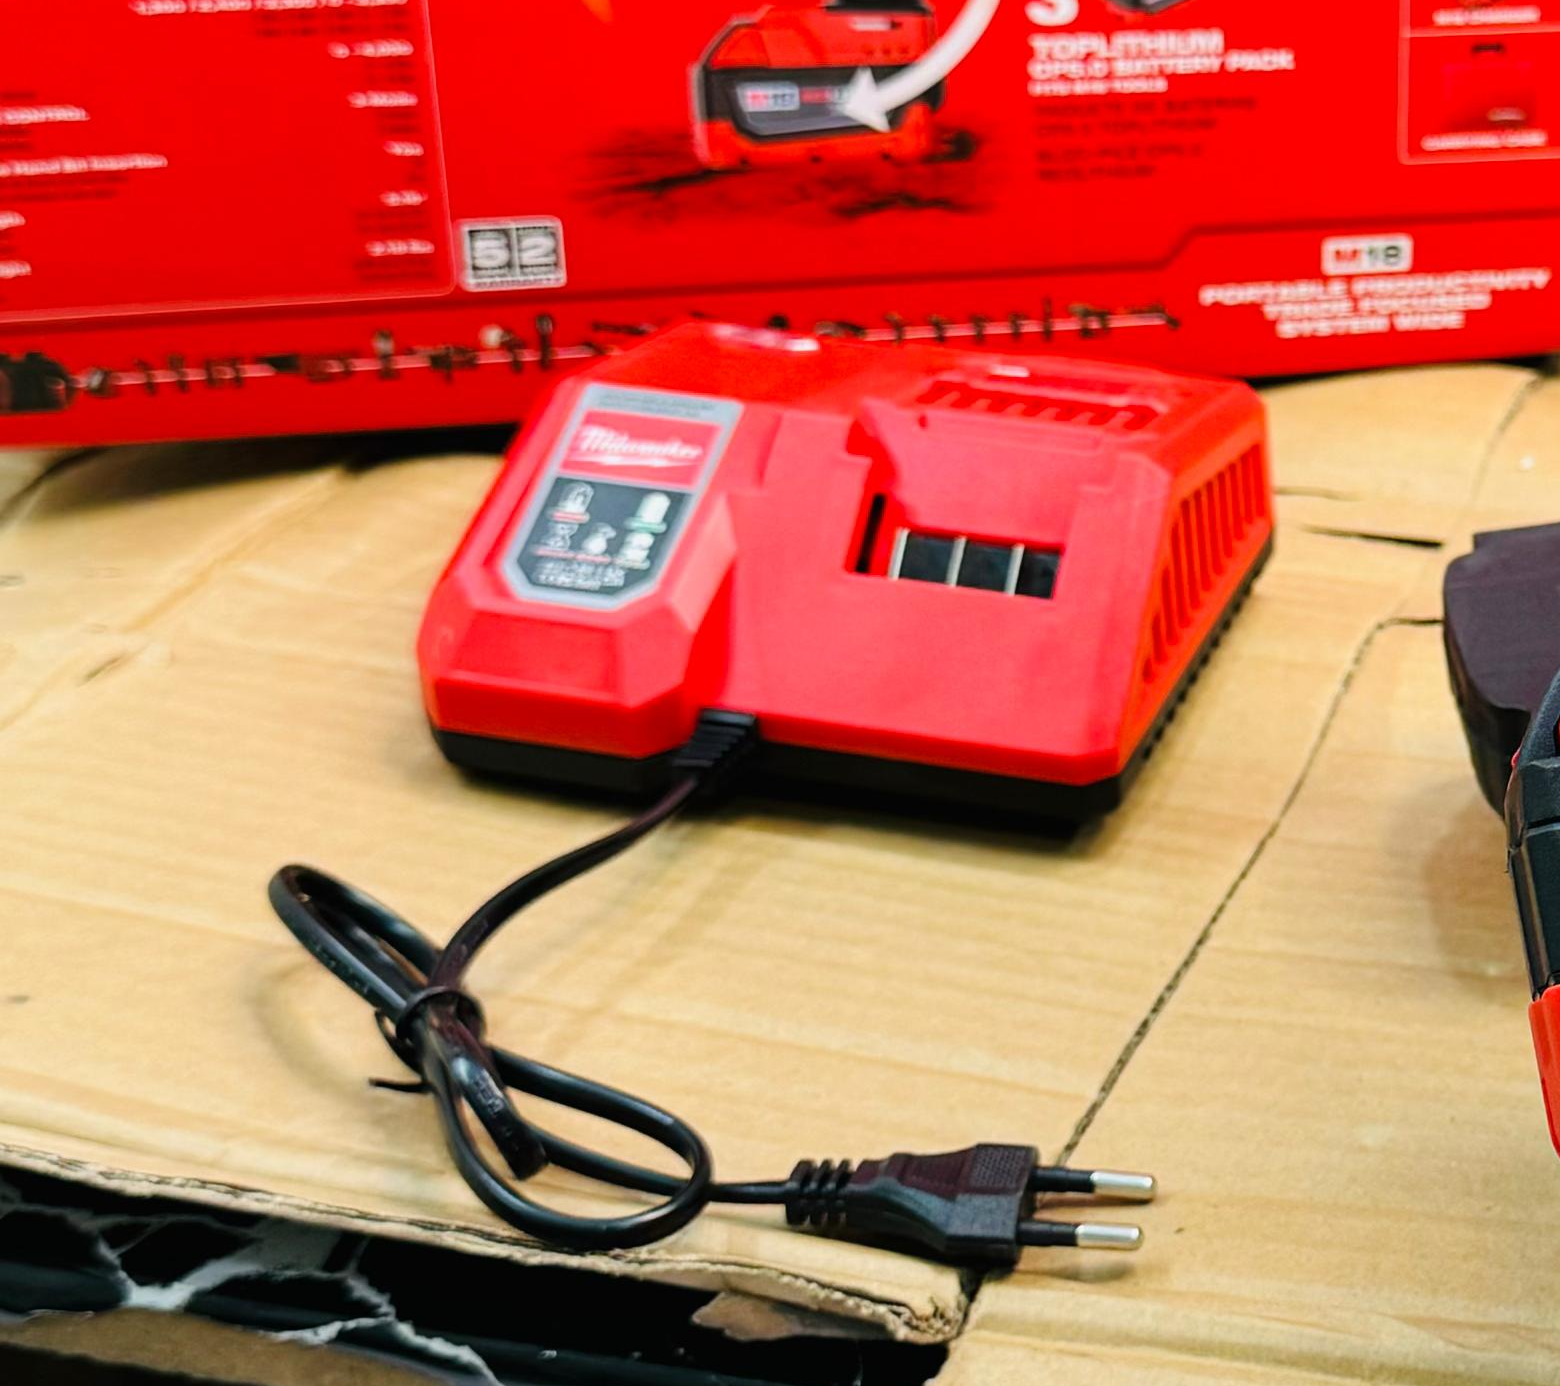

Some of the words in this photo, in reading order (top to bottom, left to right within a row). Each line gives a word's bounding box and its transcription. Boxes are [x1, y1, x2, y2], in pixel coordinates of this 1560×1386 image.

[1027, 28, 1224, 59] TOPLITHIUM
[1200, 277, 1349, 306] PORTABLE
[1276, 313, 1390, 339] SYSTEM
[1393, 310, 1466, 332] WIDE
